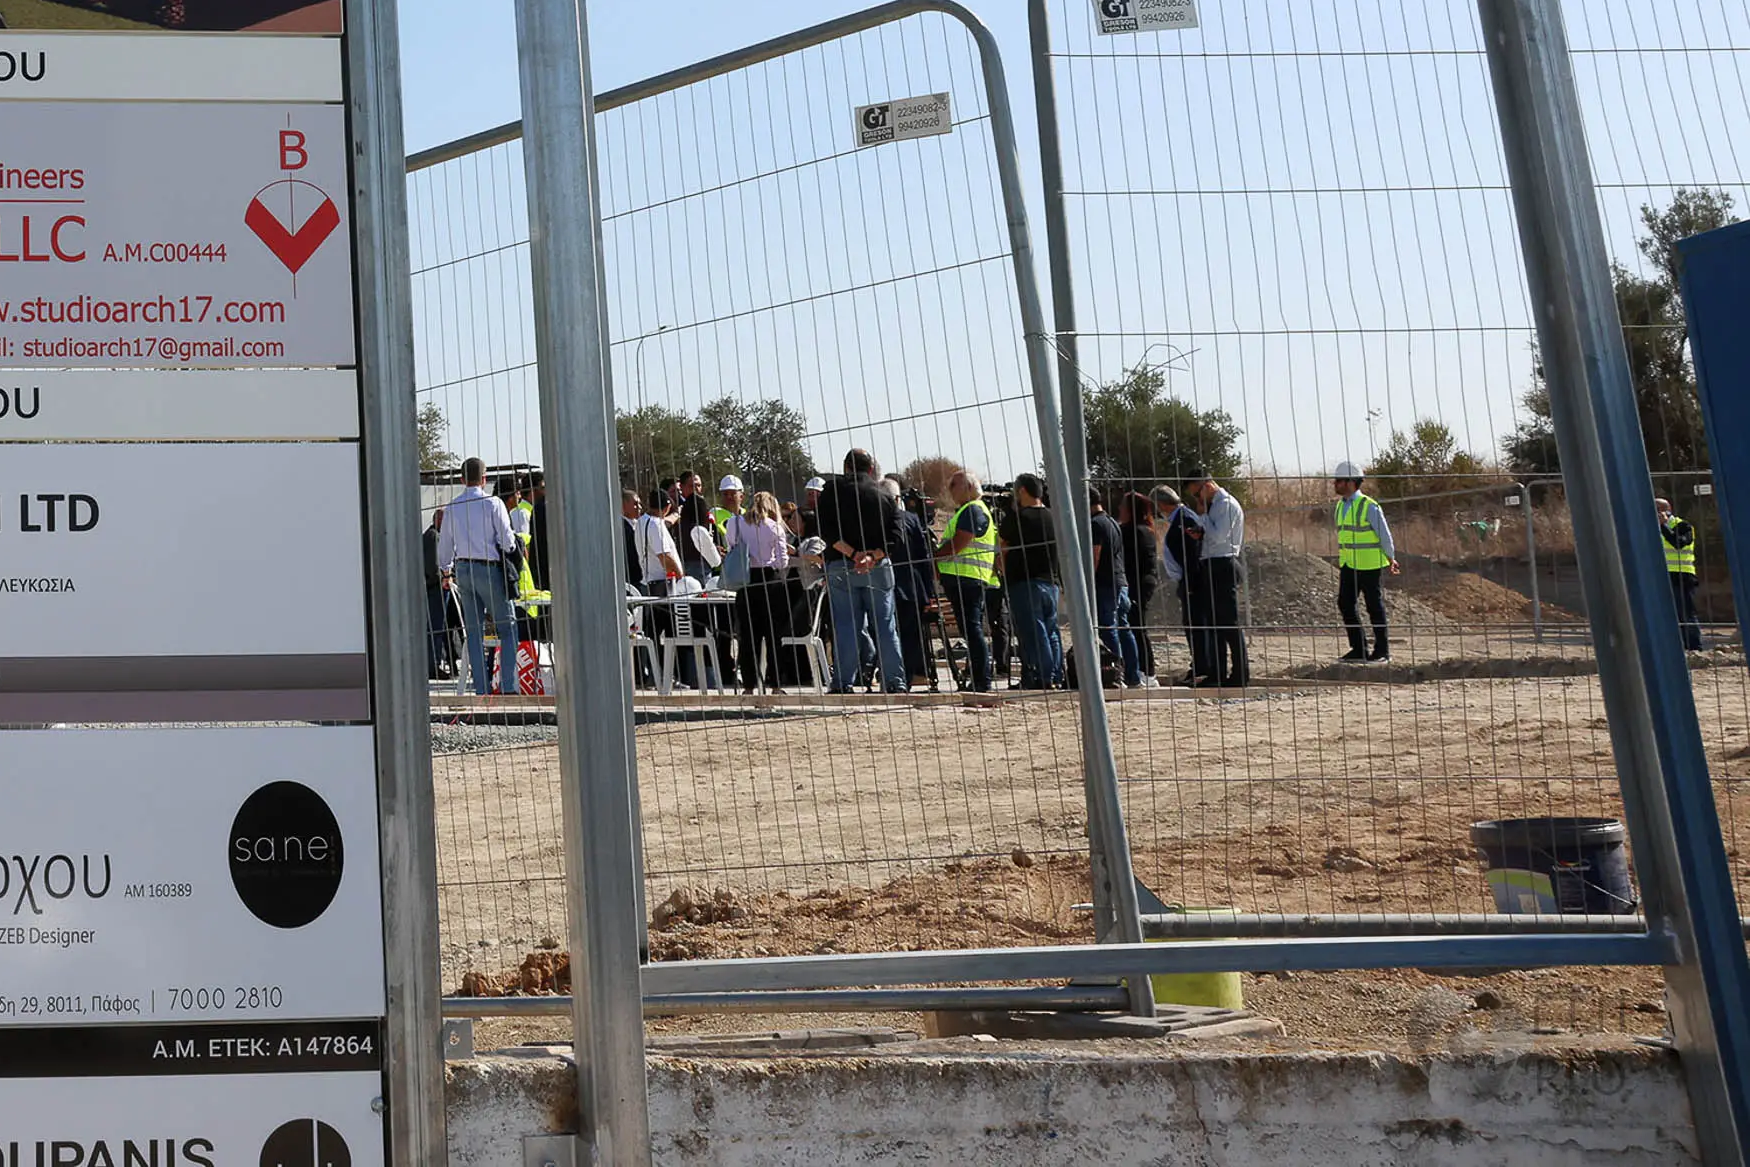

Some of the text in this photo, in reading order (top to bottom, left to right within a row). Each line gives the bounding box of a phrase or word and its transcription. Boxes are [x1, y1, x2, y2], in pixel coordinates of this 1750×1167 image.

[22, 335, 285, 362] studioarch17@gmail.com
[19, 493, 100, 533] LTD
[123, 880, 193, 899] ΑΜ 160389
[29, 927, 96, 949] Designer
[20, 996, 43, 1017] 29,
[44, 995, 88, 1016] 8011,
[91, 993, 141, 1016] Πάφος
[167, 984, 283, 1011] 7000 2810
[152, 1035, 374, 1059] Α.Μ. ΕΤΕΚ: Α147864
